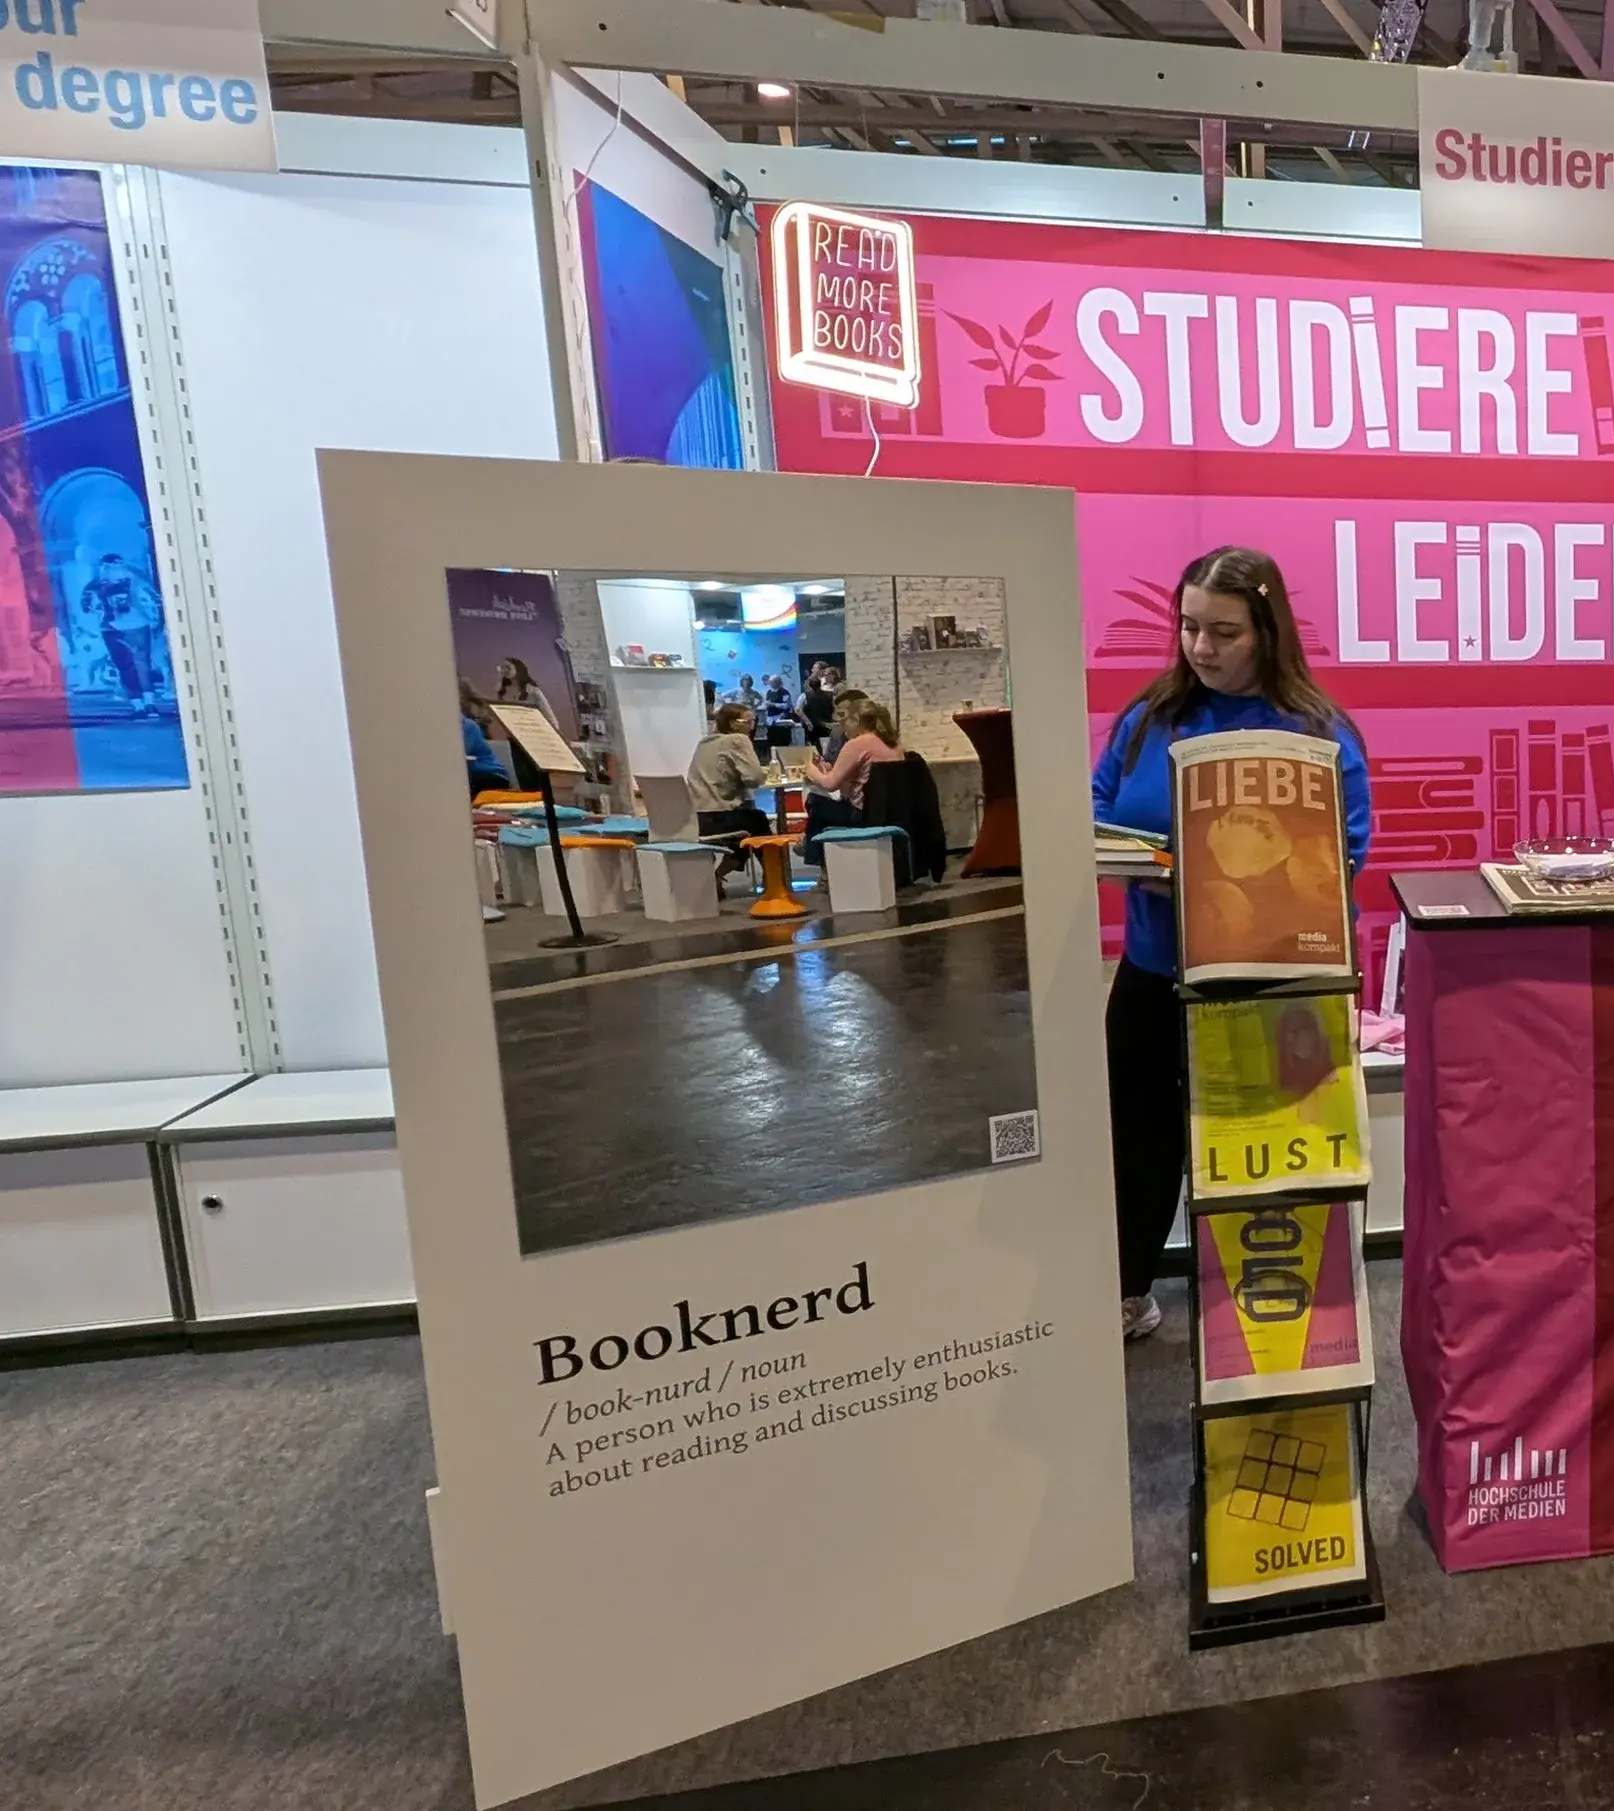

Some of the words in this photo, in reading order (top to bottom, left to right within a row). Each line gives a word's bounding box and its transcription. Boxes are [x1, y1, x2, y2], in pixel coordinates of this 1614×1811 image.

[0, 0, 85, 36] ur
[15, 50, 258, 130] degree
[814, 221, 897, 272] READ
[817, 272, 892, 315] MORE
[813, 310, 903, 359] BOOKS
[1076, 286, 1580, 457] STUDIERE
[1189, 759, 1326, 812] LIEBE
[1298, 931, 1327, 942] media
[1208, 1133, 1348, 1182] LUST
[533, 1261, 875, 1385] Booknerd
[1307, 1336, 1359, 1352] media
[545, 1443, 566, 1465] A
[576, 1417, 675, 1464] person
[683, 1400, 742, 1431] who
[749, 1392, 770, 1412] is
[777, 1357, 907, 1405] extremely
[913, 1319, 1055, 1371] enthusiastic
[566, 1368, 711, 1426] book-nurd
[741, 1351, 807, 1383] noun
[549, 1459, 632, 1498] about
[642, 1429, 748, 1473] reading
[755, 1411, 804, 1444] and
[811, 1380, 939, 1427] discussing
[944, 1360, 1018, 1392] books.
[1467, 1507, 1500, 1526] DER
[1504, 1499, 1566, 1521] MEDIEN
[1468, 1479, 1566, 1505] HOCHSCHULE
[1254, 1535, 1346, 1574] SOLVED
